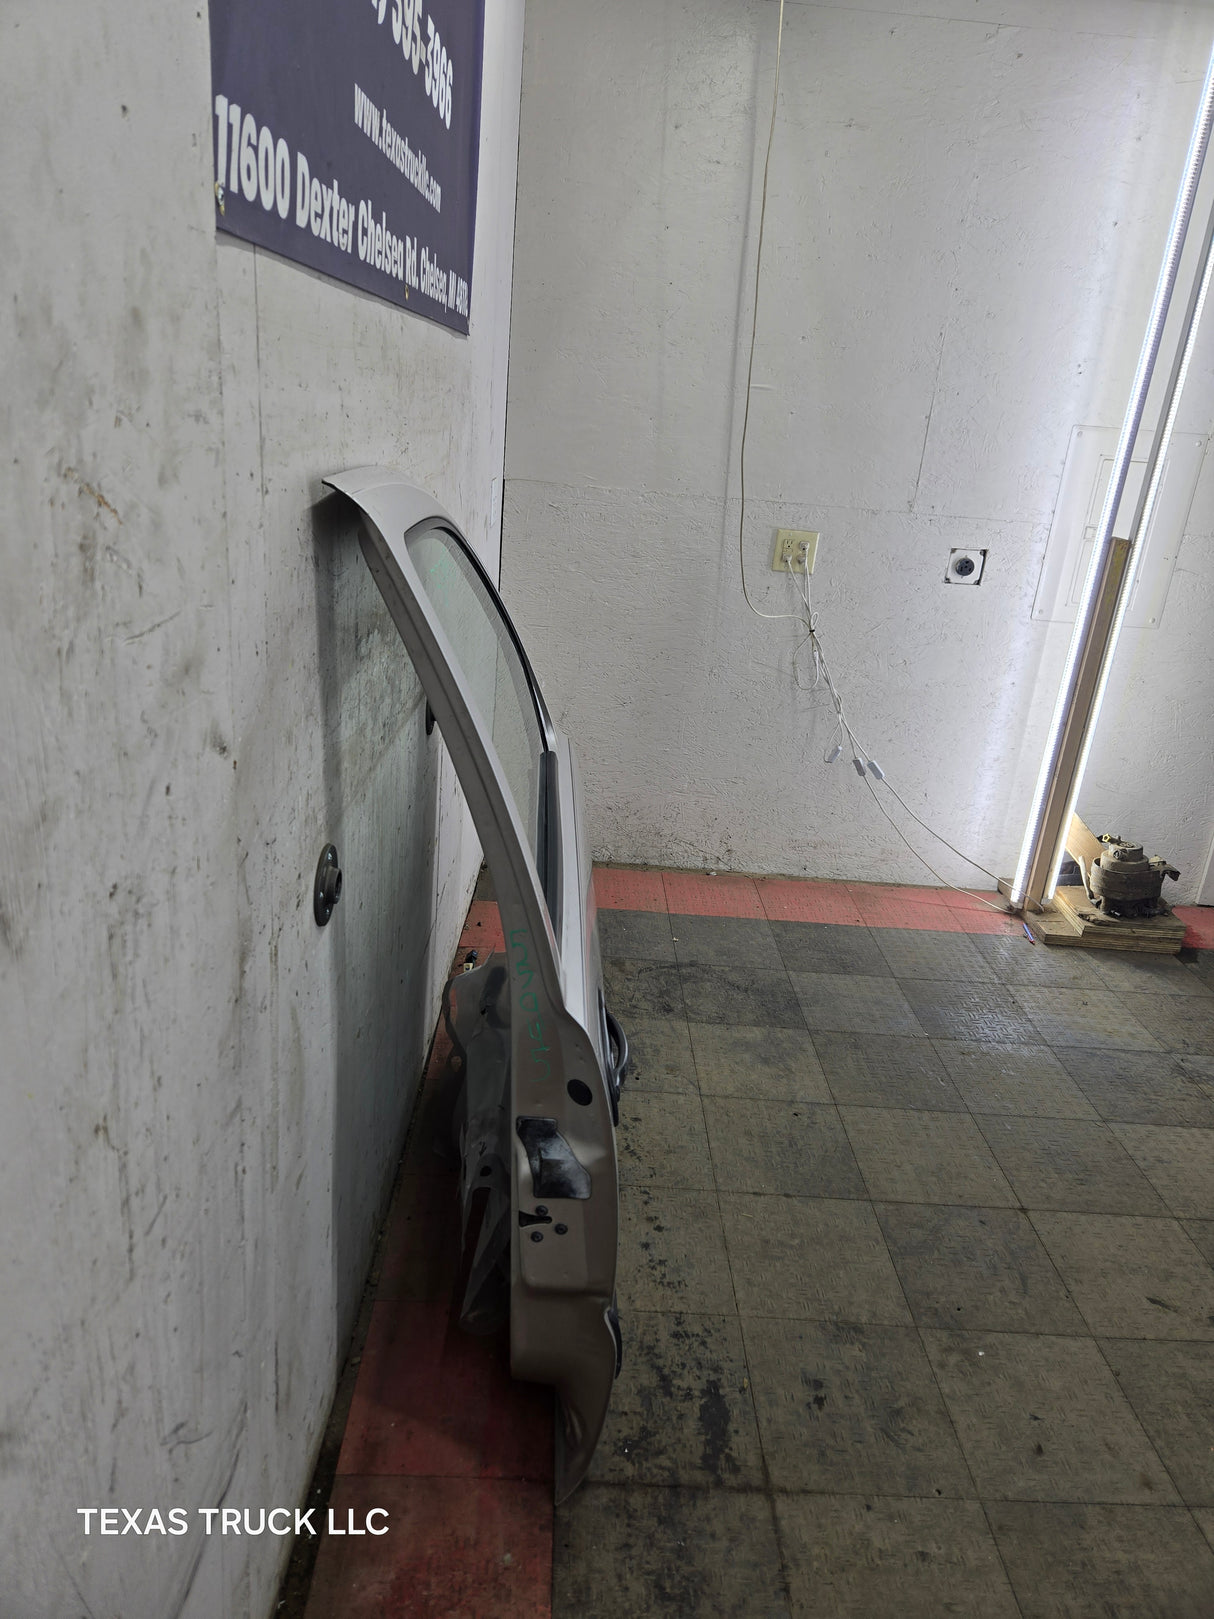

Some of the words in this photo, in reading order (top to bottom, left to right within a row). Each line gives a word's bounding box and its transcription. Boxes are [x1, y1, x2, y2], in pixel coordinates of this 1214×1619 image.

[215, 94, 290, 220] 11600
[295, 152, 355, 253] Dexter
[358, 199, 404, 280] Chelsea
[405, 235, 419, 290] Rd.
[420, 246, 447, 313] Chelsea,
